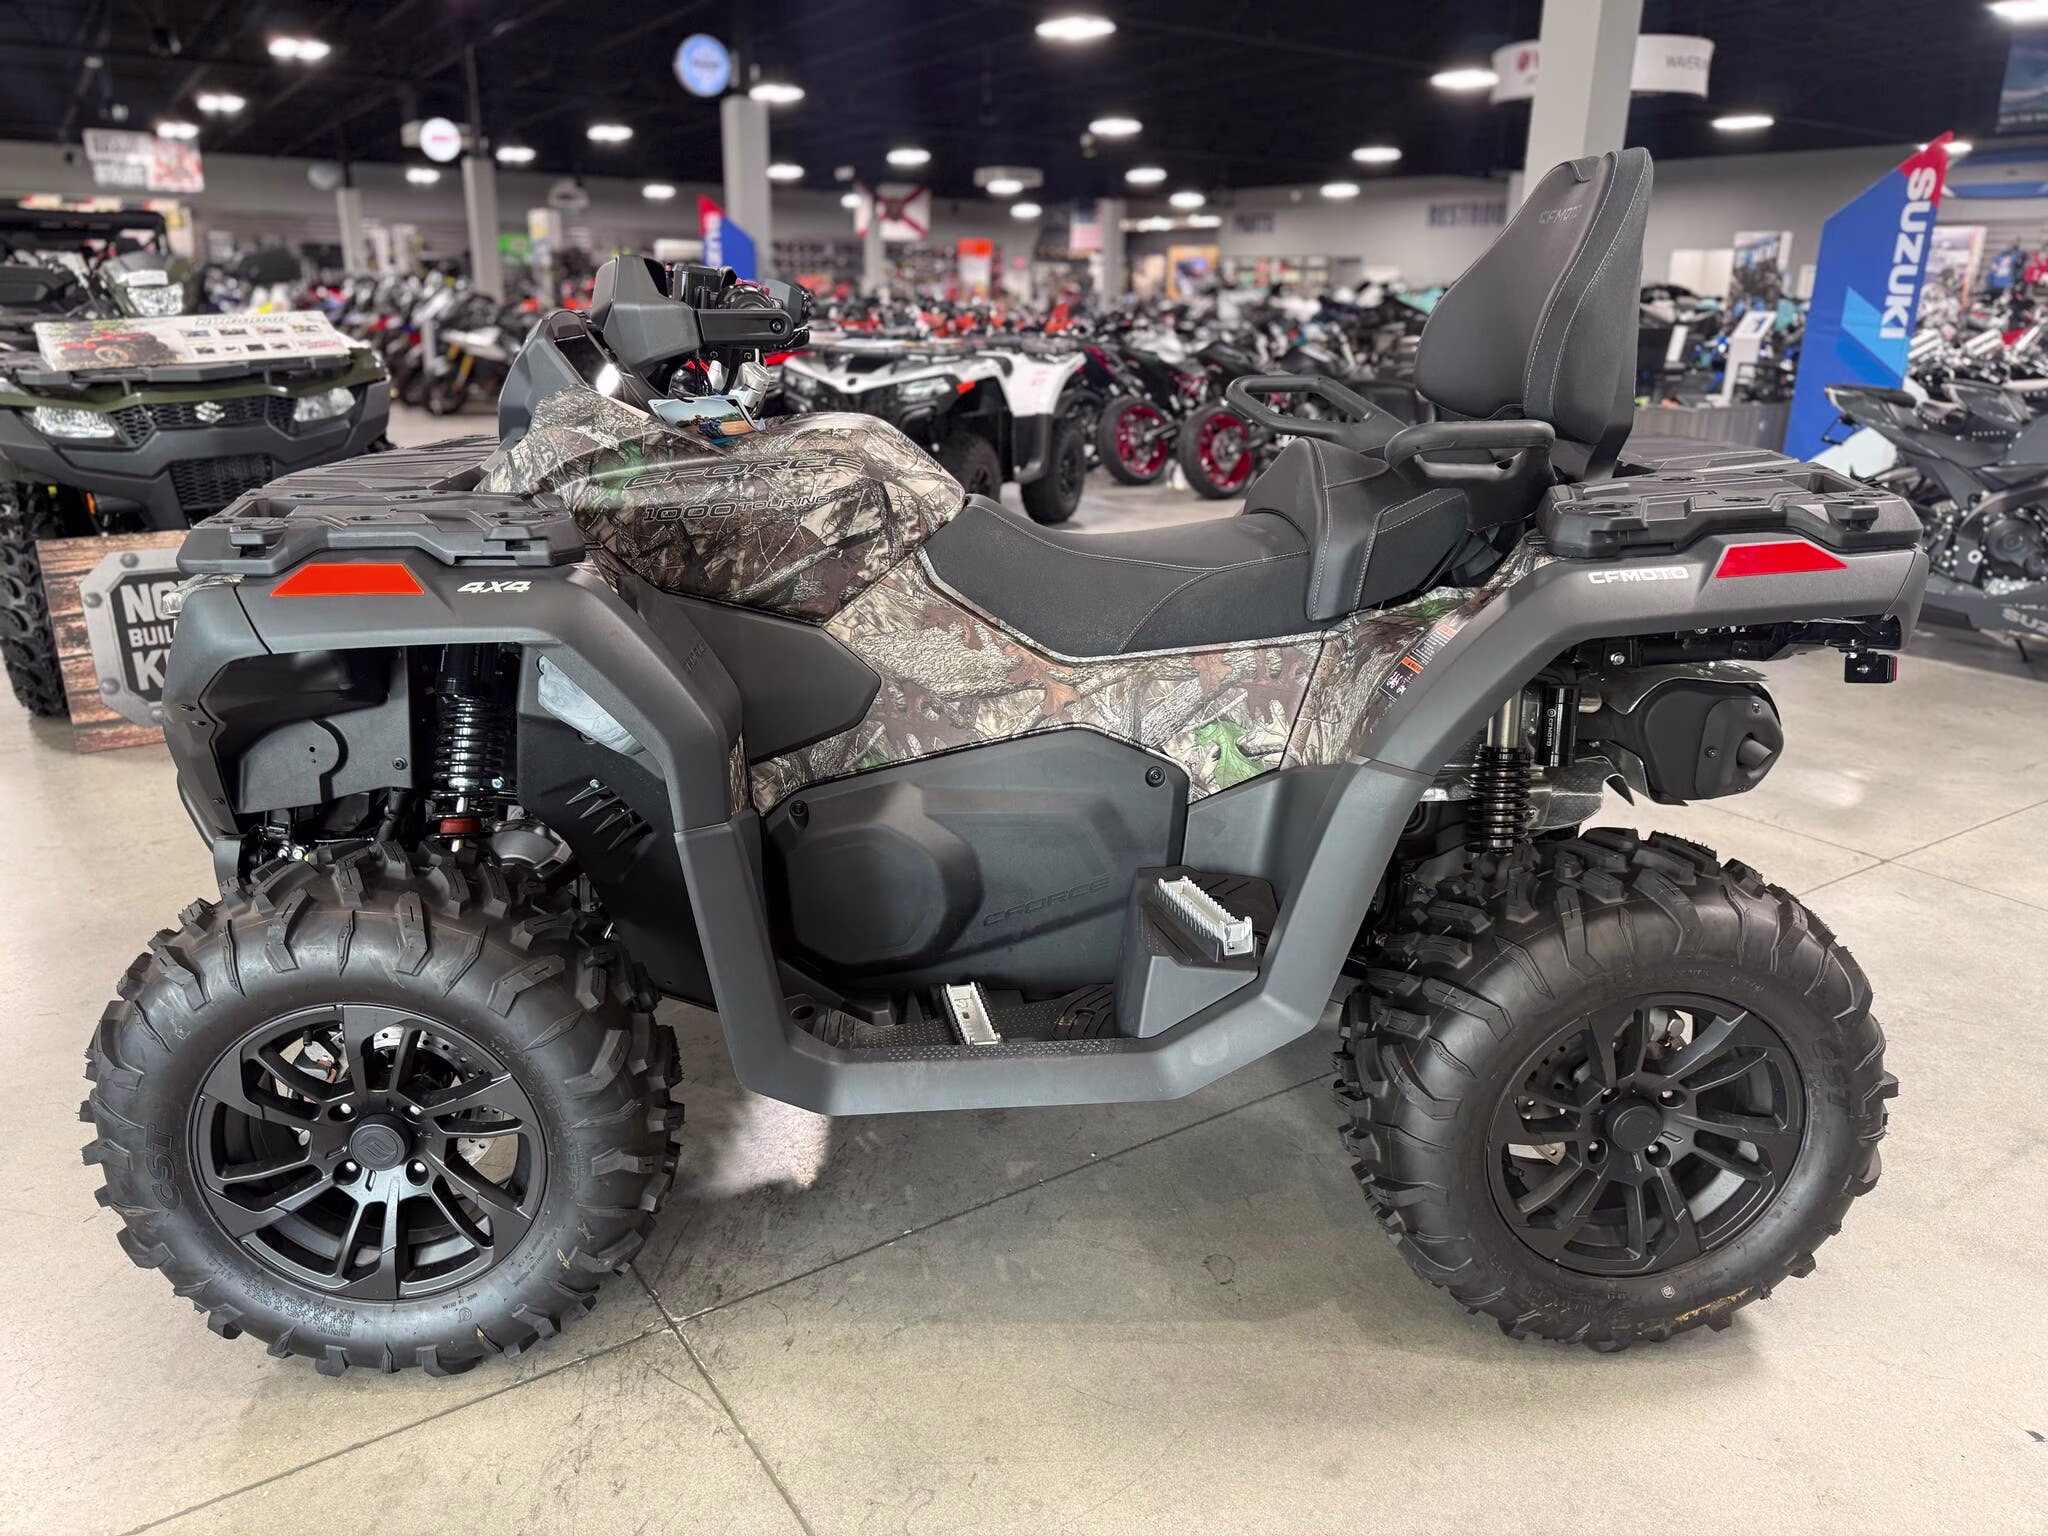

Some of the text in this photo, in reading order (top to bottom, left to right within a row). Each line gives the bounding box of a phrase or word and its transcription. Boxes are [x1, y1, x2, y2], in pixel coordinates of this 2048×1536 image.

[1880, 167, 1937, 339] SUZUKI
[622, 456, 866, 490] CFORCE
[643, 496, 830, 522] 1000 TOURING
[1588, 566, 1689, 584] CFMOTO
[1546, 718, 1554, 747] CFMOTO
[144, 1120, 184, 1210] CST
